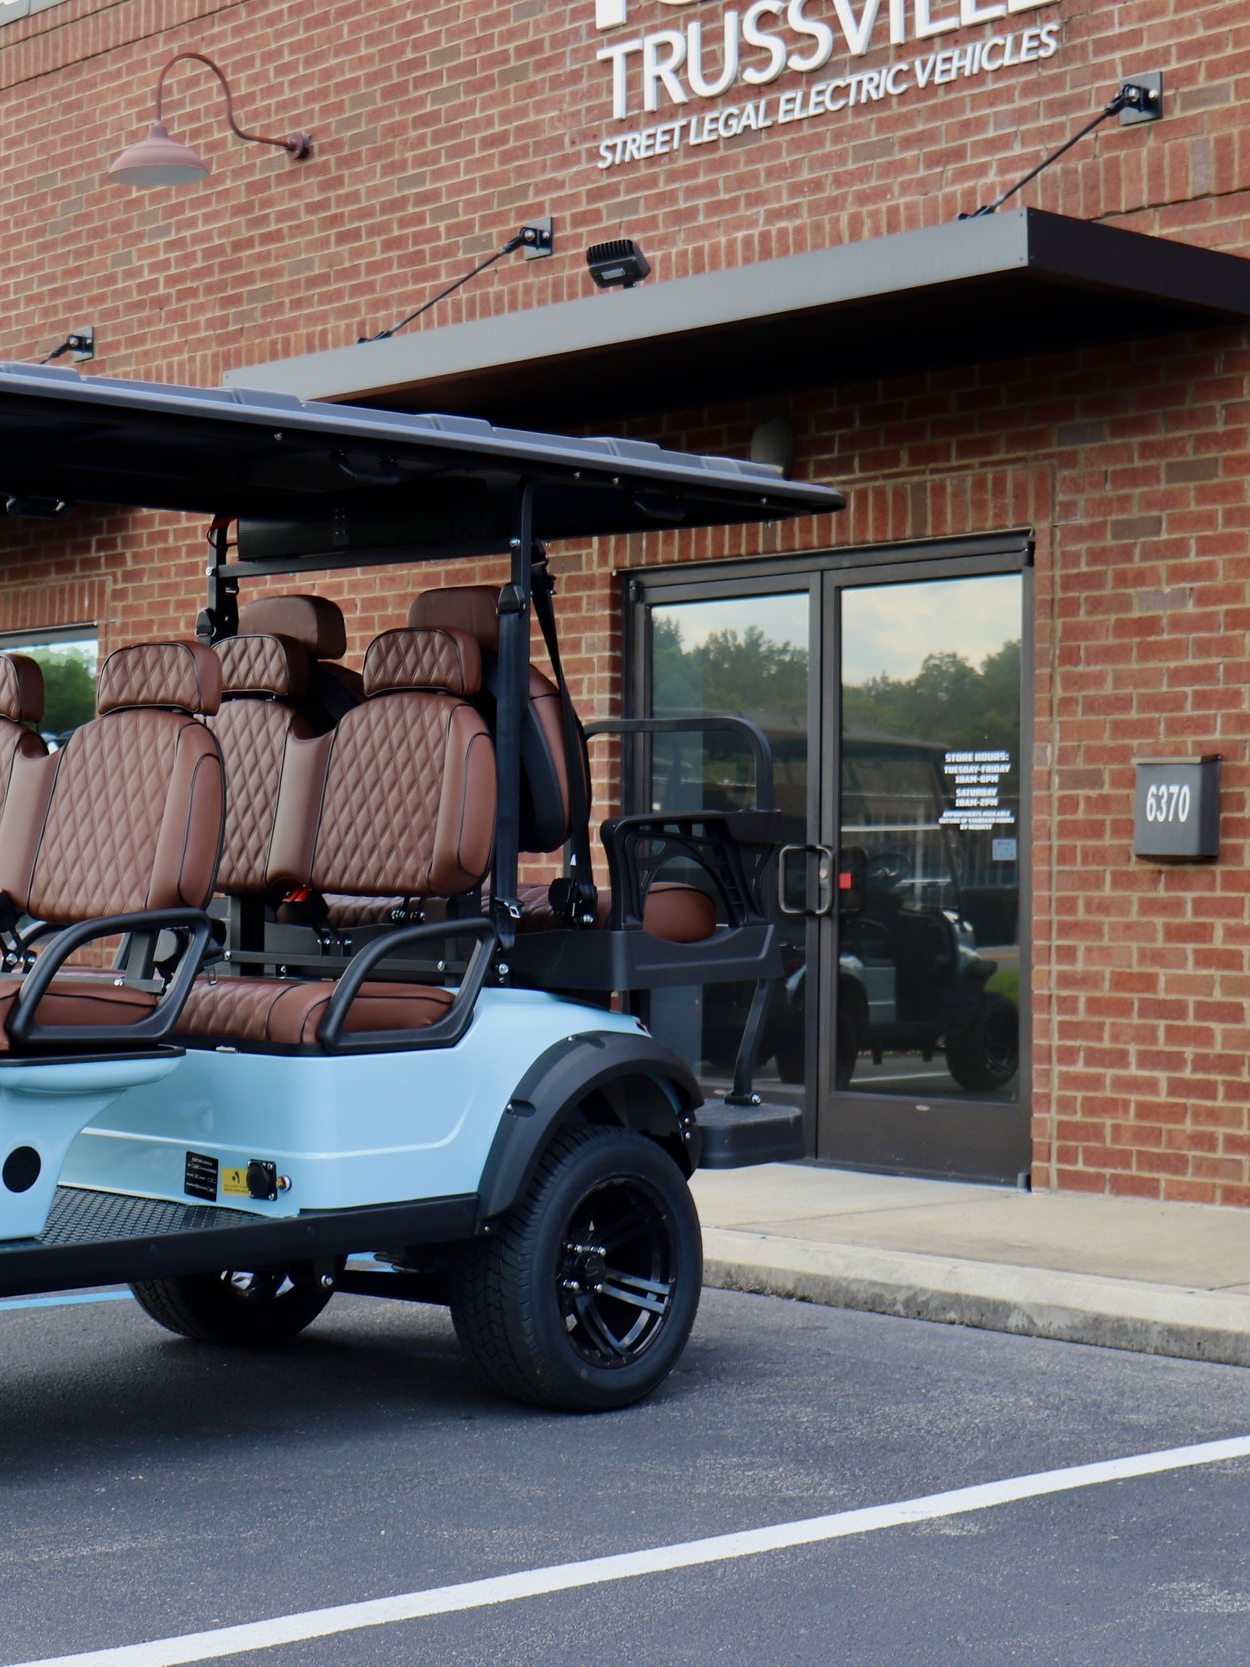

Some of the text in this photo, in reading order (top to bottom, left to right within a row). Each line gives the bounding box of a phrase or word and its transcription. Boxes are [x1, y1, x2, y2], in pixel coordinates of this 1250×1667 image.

[596, 0, 1061, 119] TRUSSVILL
[597, 23, 1061, 169] STREET LEGAL ELECTRIC VEHICLES
[945, 751, 1010, 762] STORE HOURS:
[955, 787, 998, 797] SATURDAY
[1146, 784, 1190, 823] 6370
